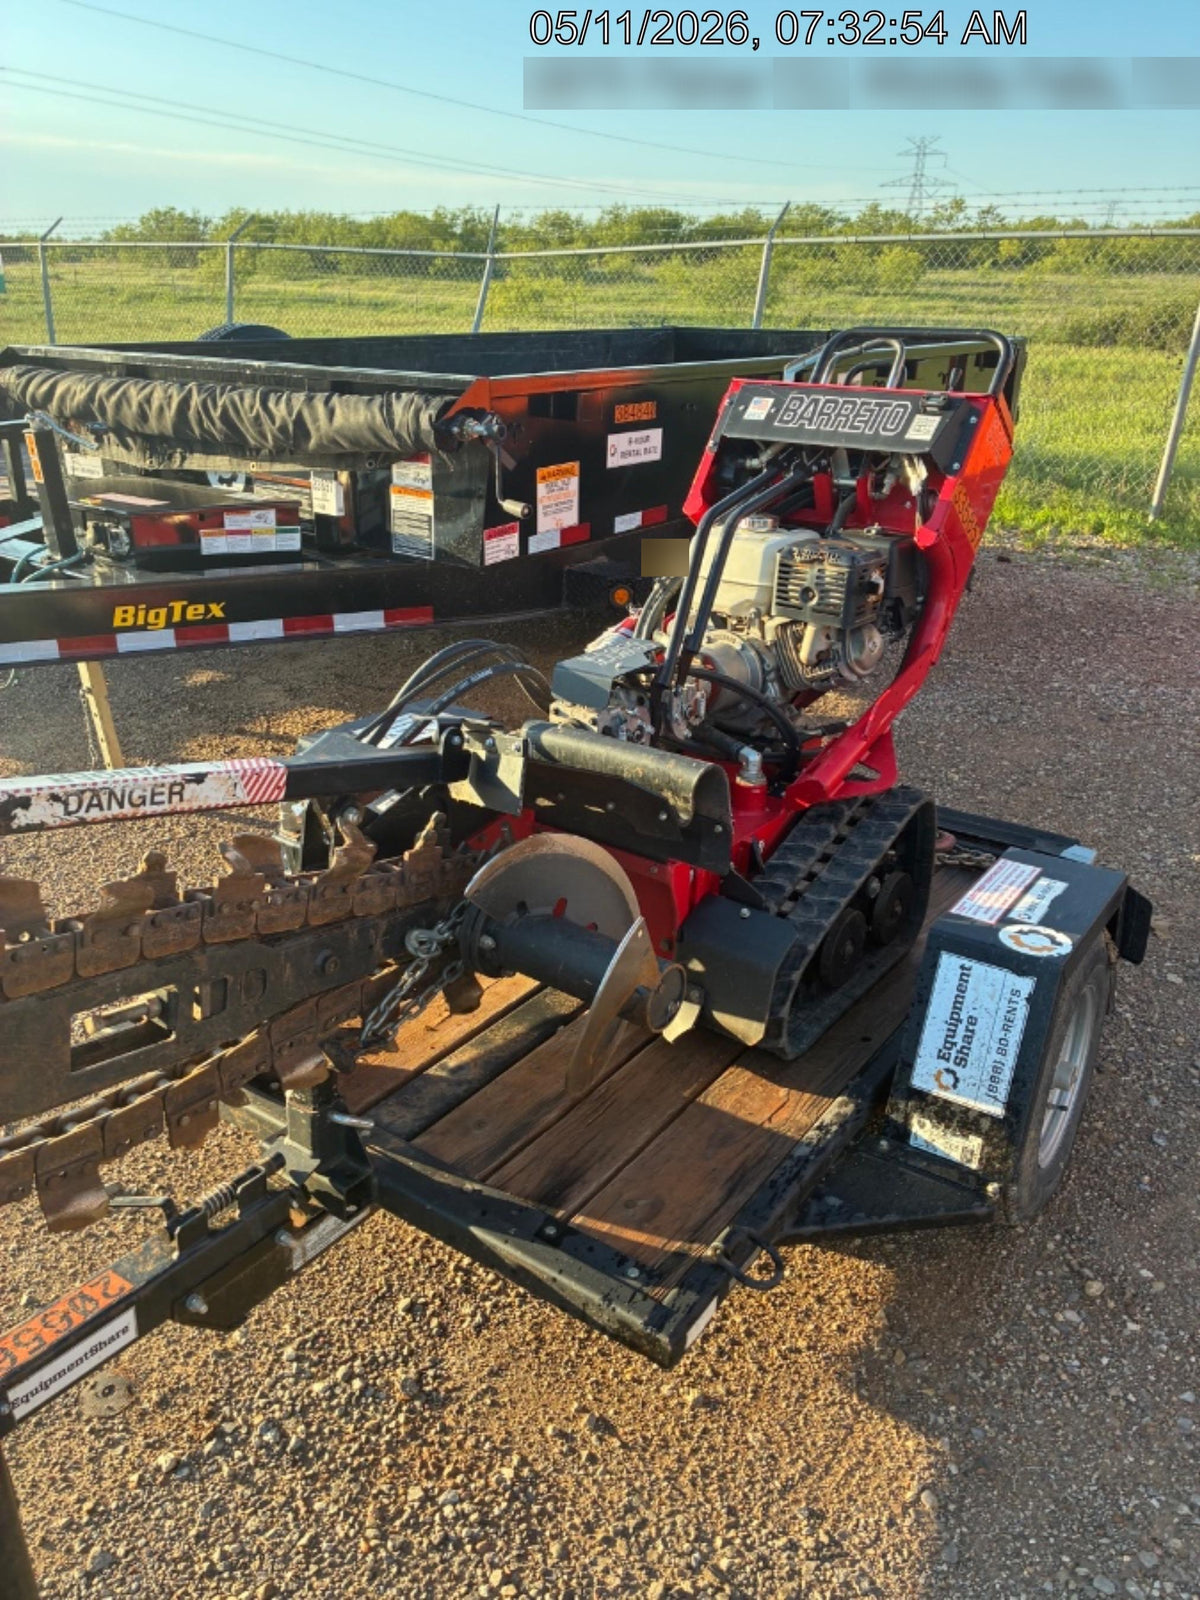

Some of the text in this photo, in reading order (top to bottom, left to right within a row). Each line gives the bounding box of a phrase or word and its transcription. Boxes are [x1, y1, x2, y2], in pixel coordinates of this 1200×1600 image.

[773, 395, 912, 436] BARRETO
[112, 600, 226, 630] BigTex
[62, 781, 186, 817] DANGER
[936, 962, 973, 1063] Equipment
[997, 988, 1022, 1058] 80-RENTS
[953, 1014, 978, 1070] Share
[9, 1324, 130, 1411] EquipmentShare
